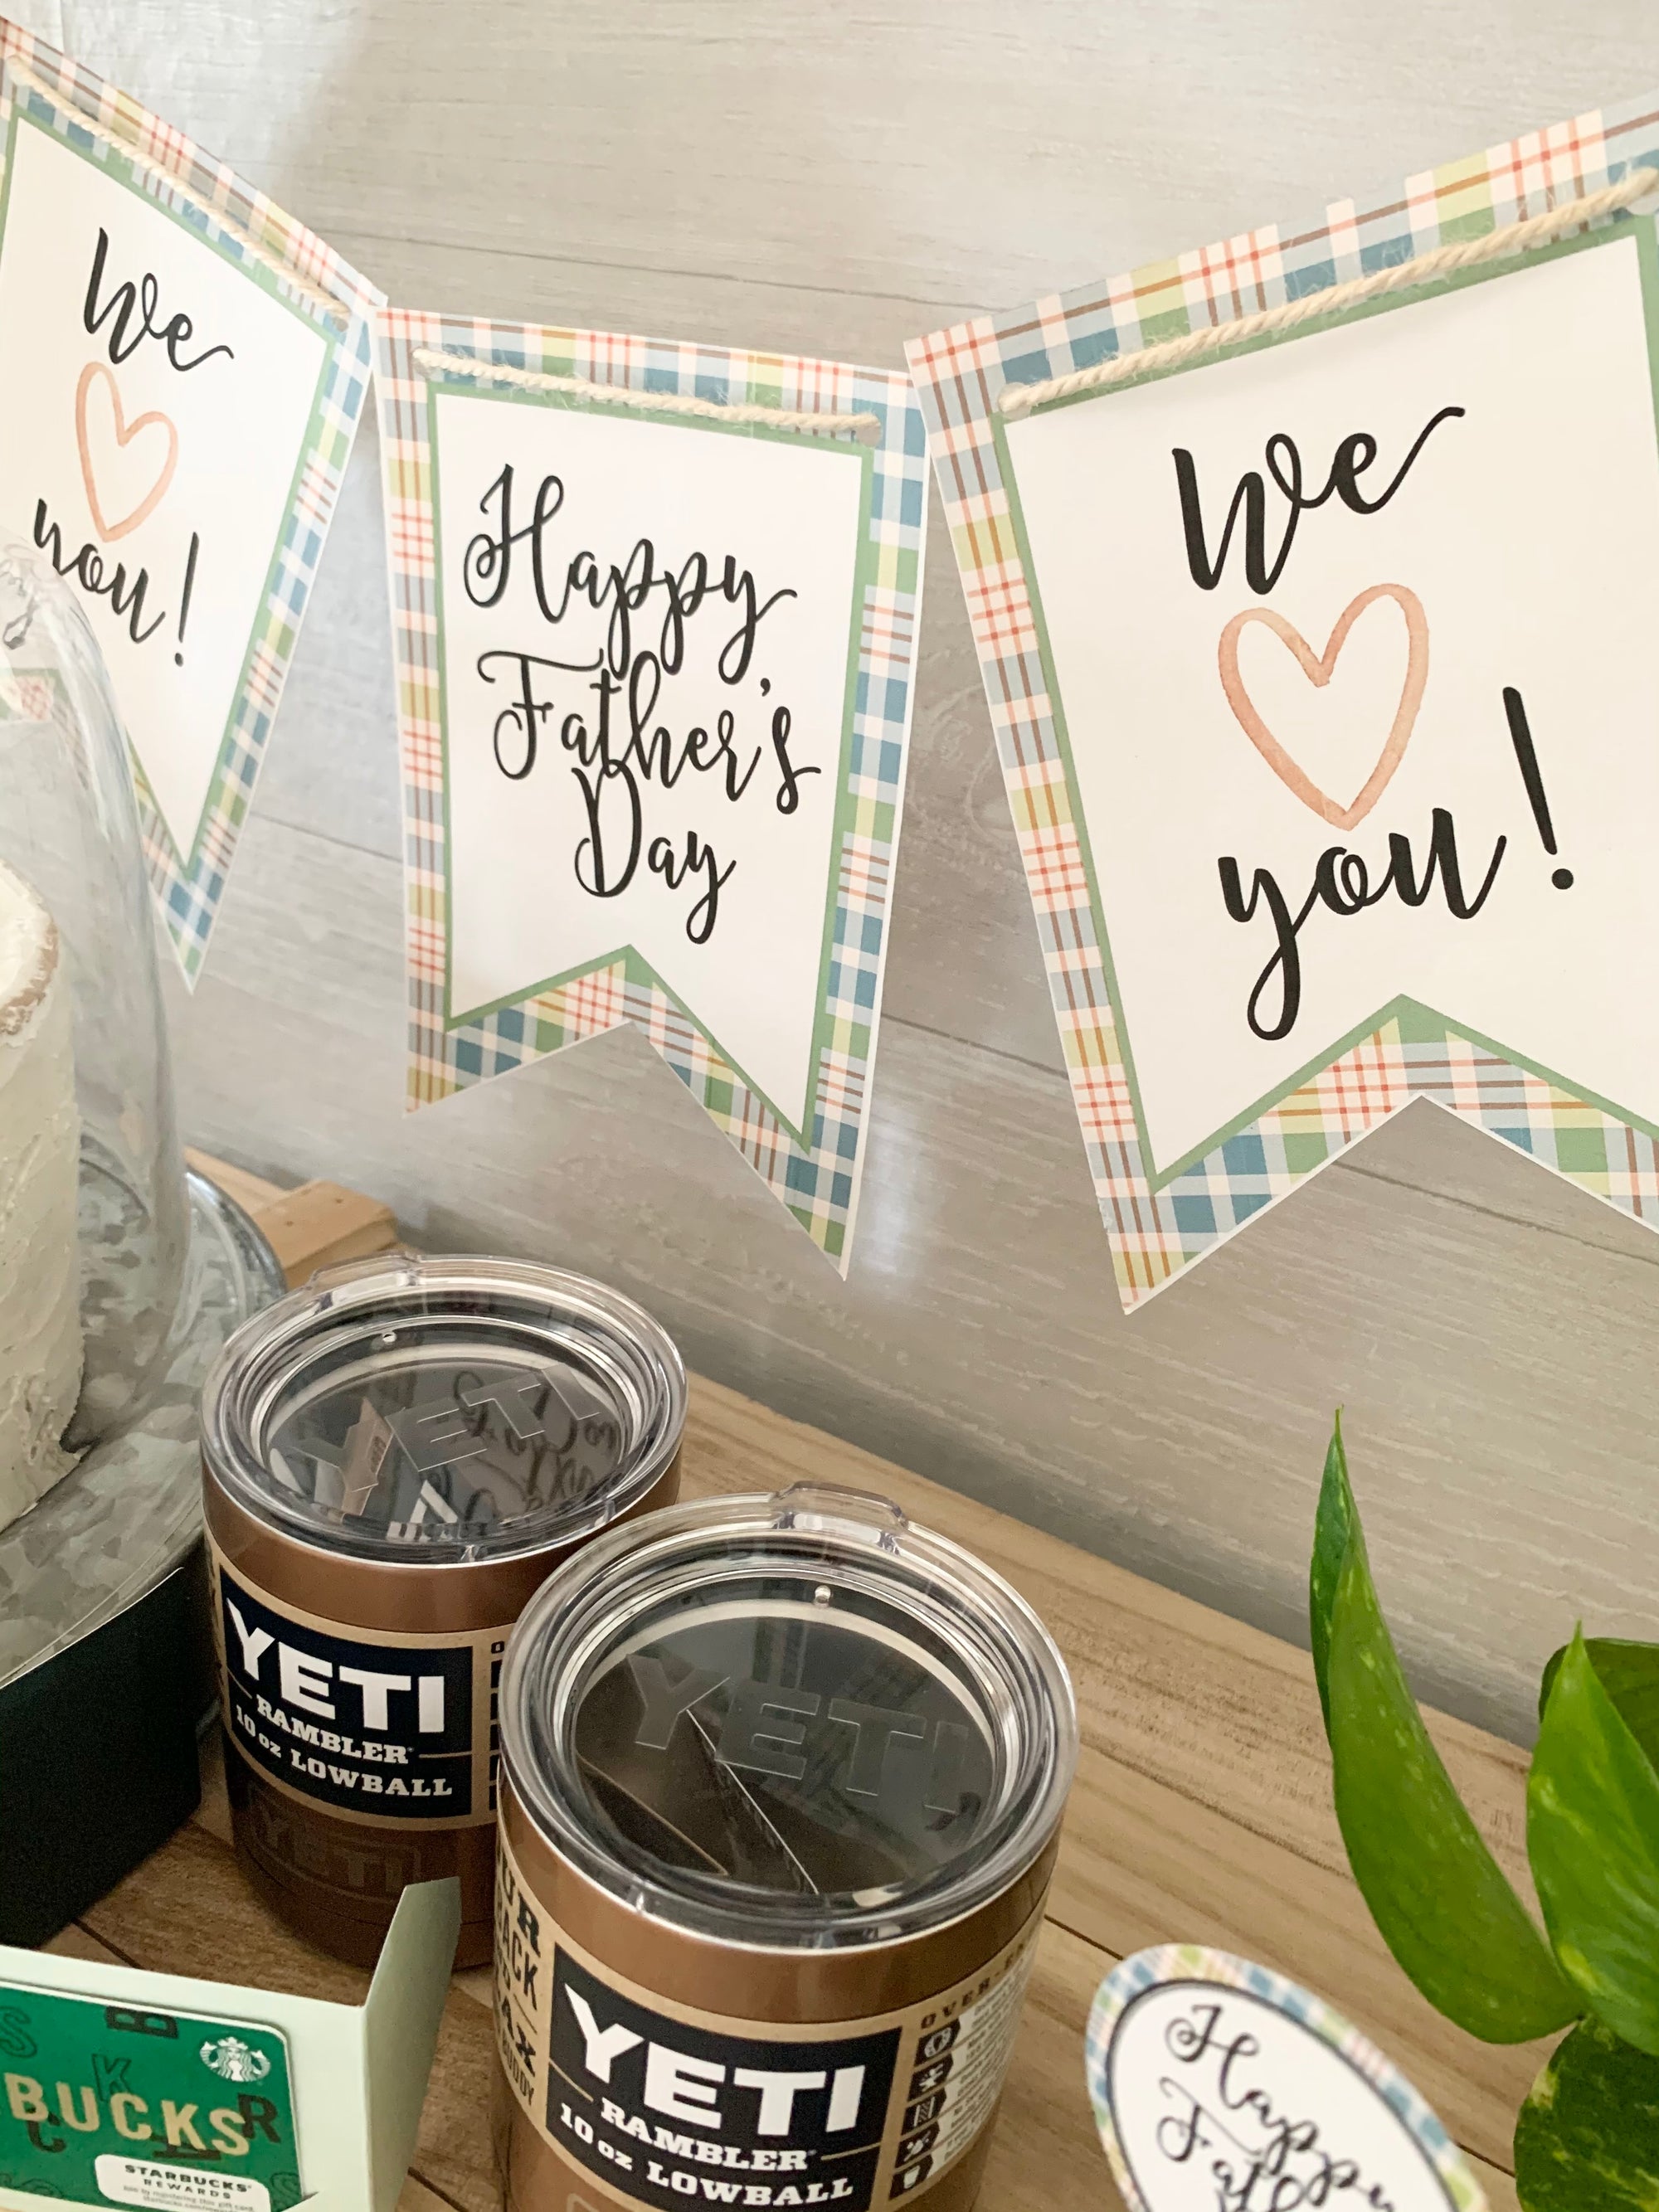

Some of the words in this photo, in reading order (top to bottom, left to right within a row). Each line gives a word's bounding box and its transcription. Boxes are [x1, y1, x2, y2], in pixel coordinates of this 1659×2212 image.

[84, 226, 235, 372] We
[1171, 406, 1466, 596] We
[463, 464, 798, 684] Happy
[476, 648, 821, 816] Father's
[572, 758, 737, 945] Day
[1217, 686, 1574, 1041] you!
[226, 1597, 445, 1734] YETI
[255, 1693, 410, 1765] RAMBLER
[235, 1704, 256, 1739] 10
[258, 1731, 282, 1759] oz
[290, 1748, 454, 1797] LOWBALL
[564, 1982, 866, 2137] YETI
[124, 2164, 248, 2193] STARBUCKS
[144, 2178, 231, 2200] REWARDS
[559, 2102, 594, 2145] 10
[597, 2140, 633, 2171] oz
[646, 2161, 854, 2207] LOWBALL
[601, 2095, 809, 2171] RAMBLER
